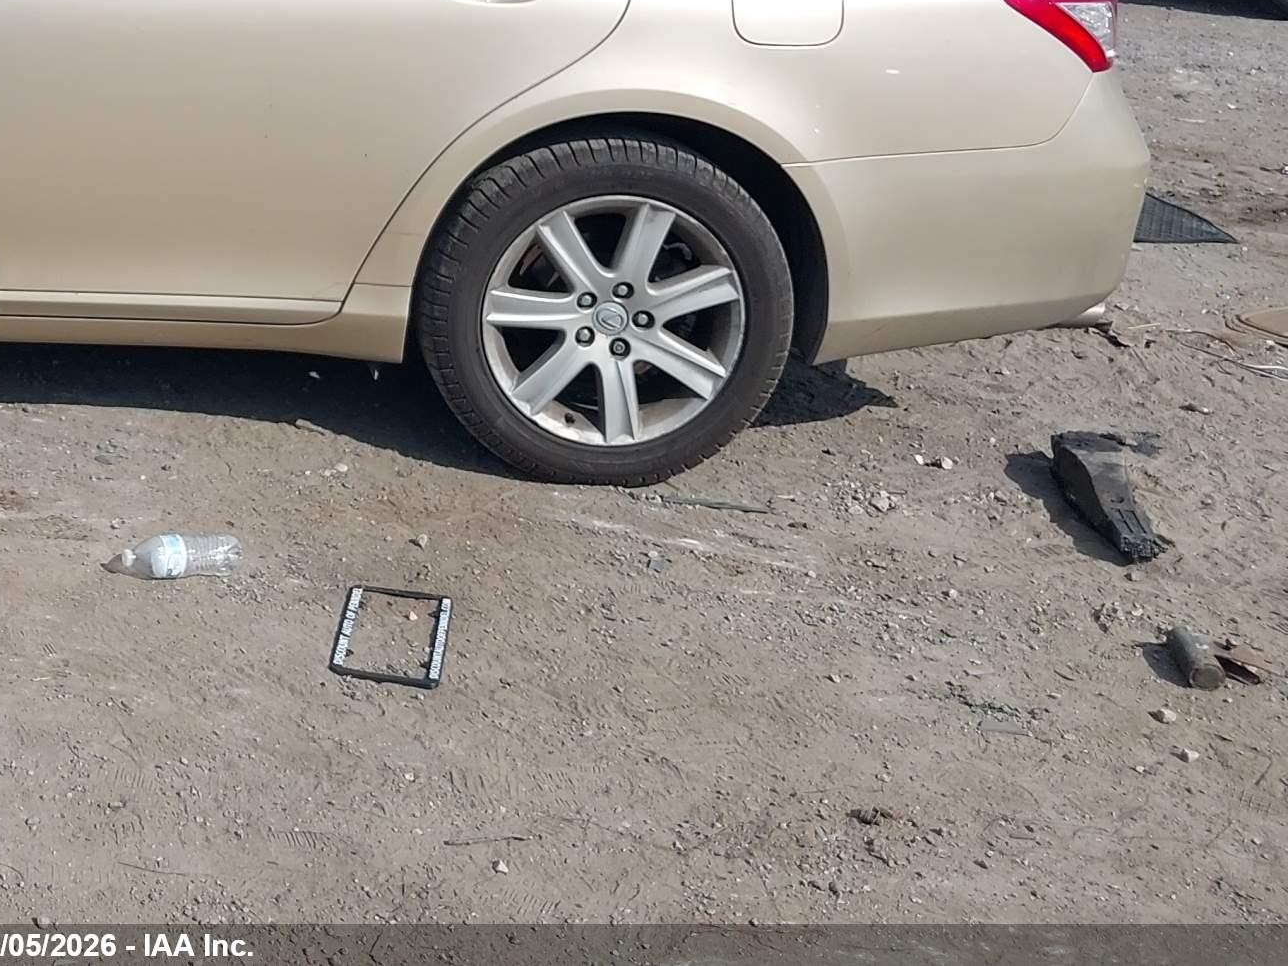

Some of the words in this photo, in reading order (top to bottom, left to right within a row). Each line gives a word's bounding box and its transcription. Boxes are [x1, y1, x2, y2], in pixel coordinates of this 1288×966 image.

[345, 609, 357, 620] OF
[341, 619, 354, 636] AUTO
[332, 634, 350, 665] DISCOUNT
